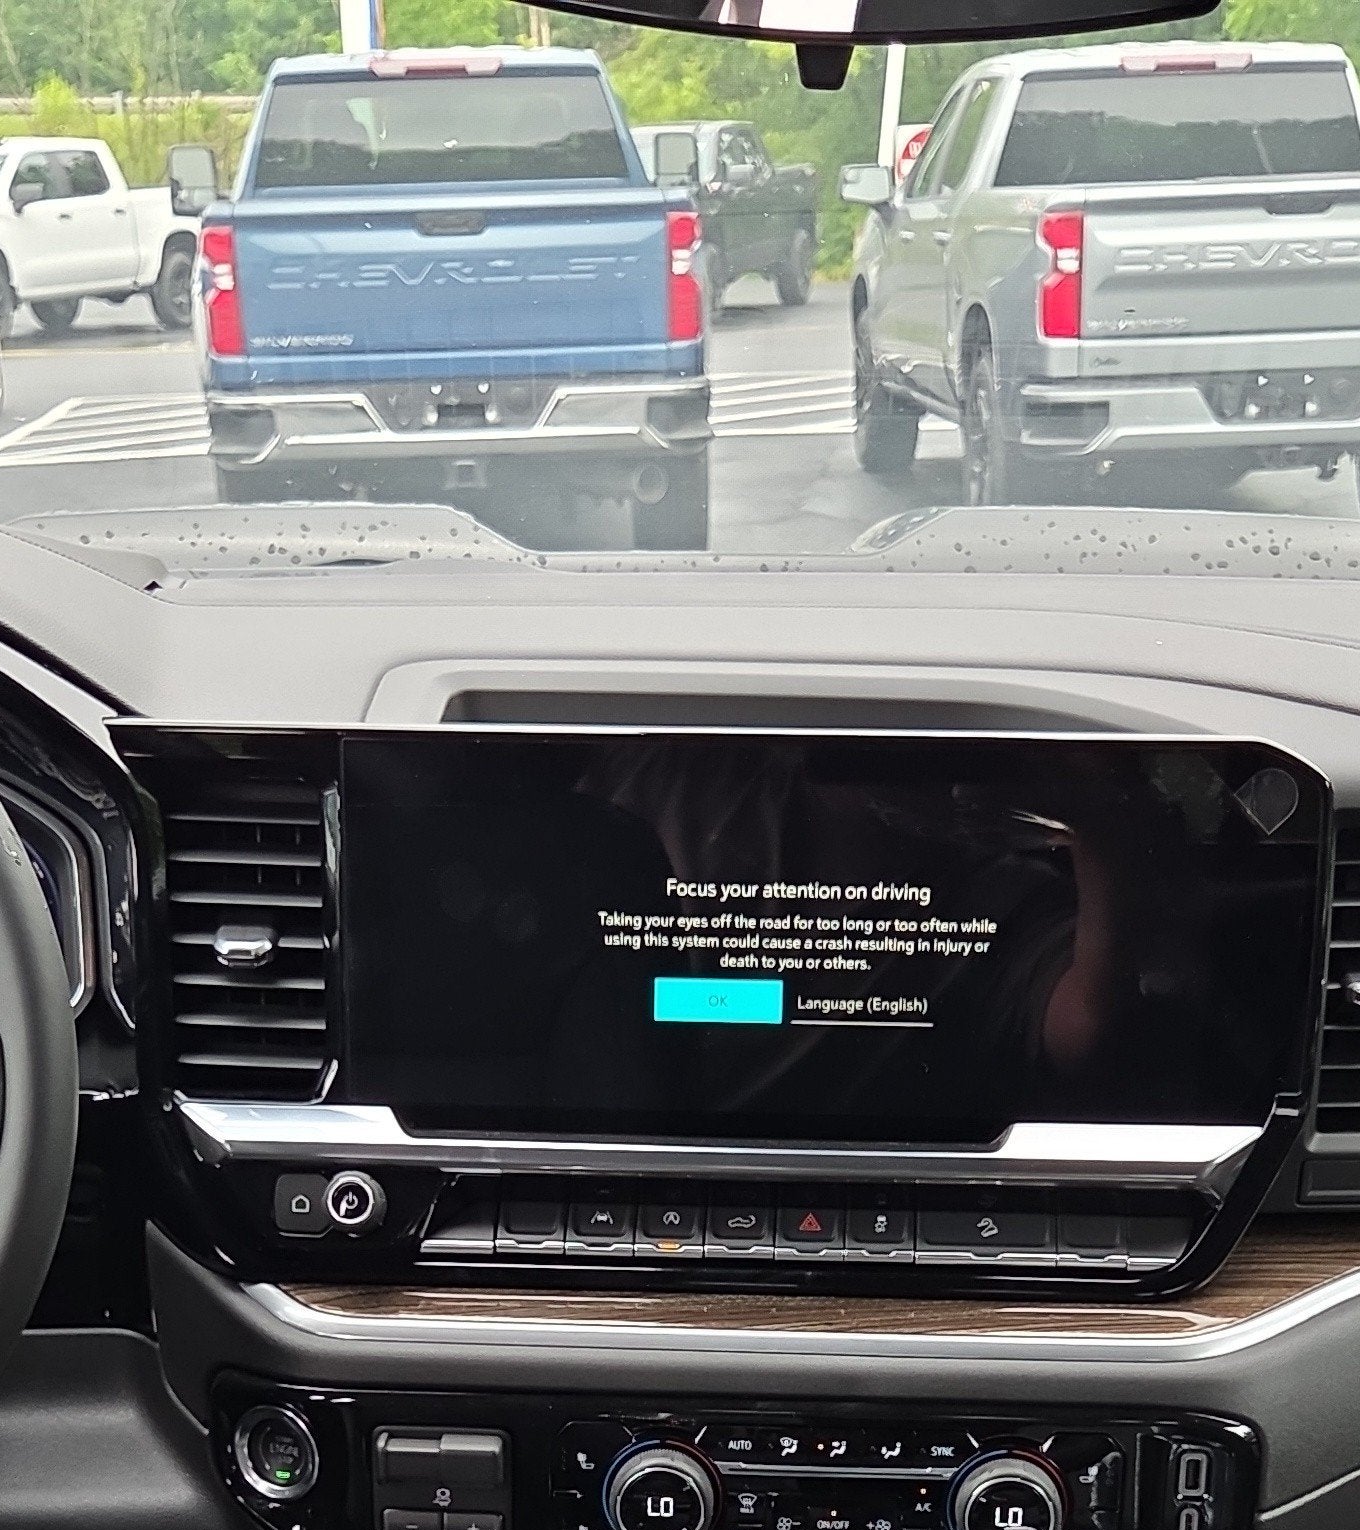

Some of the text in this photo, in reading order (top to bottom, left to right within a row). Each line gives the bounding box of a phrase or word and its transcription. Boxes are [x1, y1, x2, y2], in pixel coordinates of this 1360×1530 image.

[267, 256, 639, 289] CHEVROLET
[666, 878, 931, 905] Focus your attention on driving
[597, 912, 997, 935] Taking your eyes off the road for too long or too often while
[604, 932, 990, 957] using this system could cause a crash resulting in injury or
[719, 953, 872, 973] death to you or others.
[708, 995, 728, 1008] OK
[797, 996, 928, 1015] Language (English)
[728, 1440, 752, 1450] AUTO
[930, 1446, 955, 1457] SYNC
[647, 1497, 673, 1517] LO
[914, 1503, 932, 1512] A/C
[994, 1507, 1023, 1527] LO
[816, 1520, 850, 1530] ON/OFF
